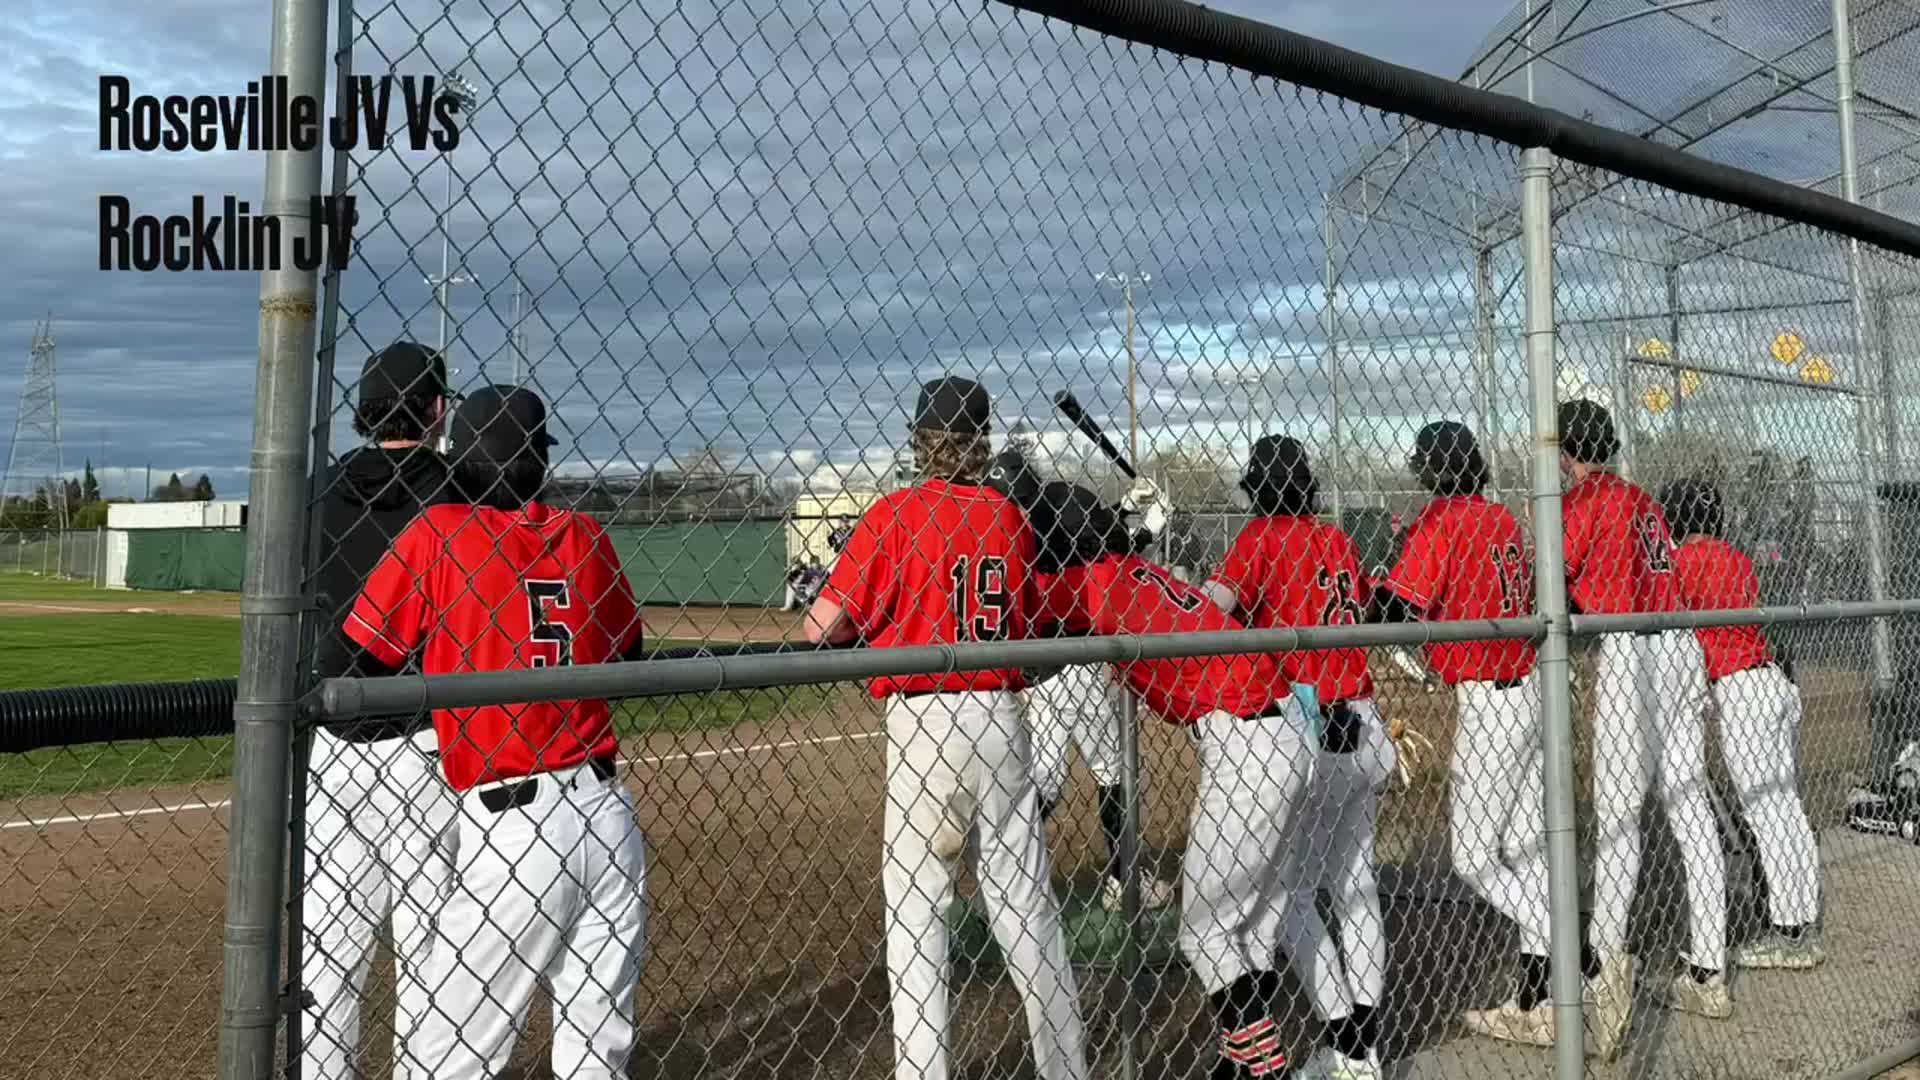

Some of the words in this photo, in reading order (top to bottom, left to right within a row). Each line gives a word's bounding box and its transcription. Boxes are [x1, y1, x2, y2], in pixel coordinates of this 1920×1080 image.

[524, 578, 573, 668] 5
[950, 554, 1009, 642] 19
[1129, 566, 1202, 613] 7
